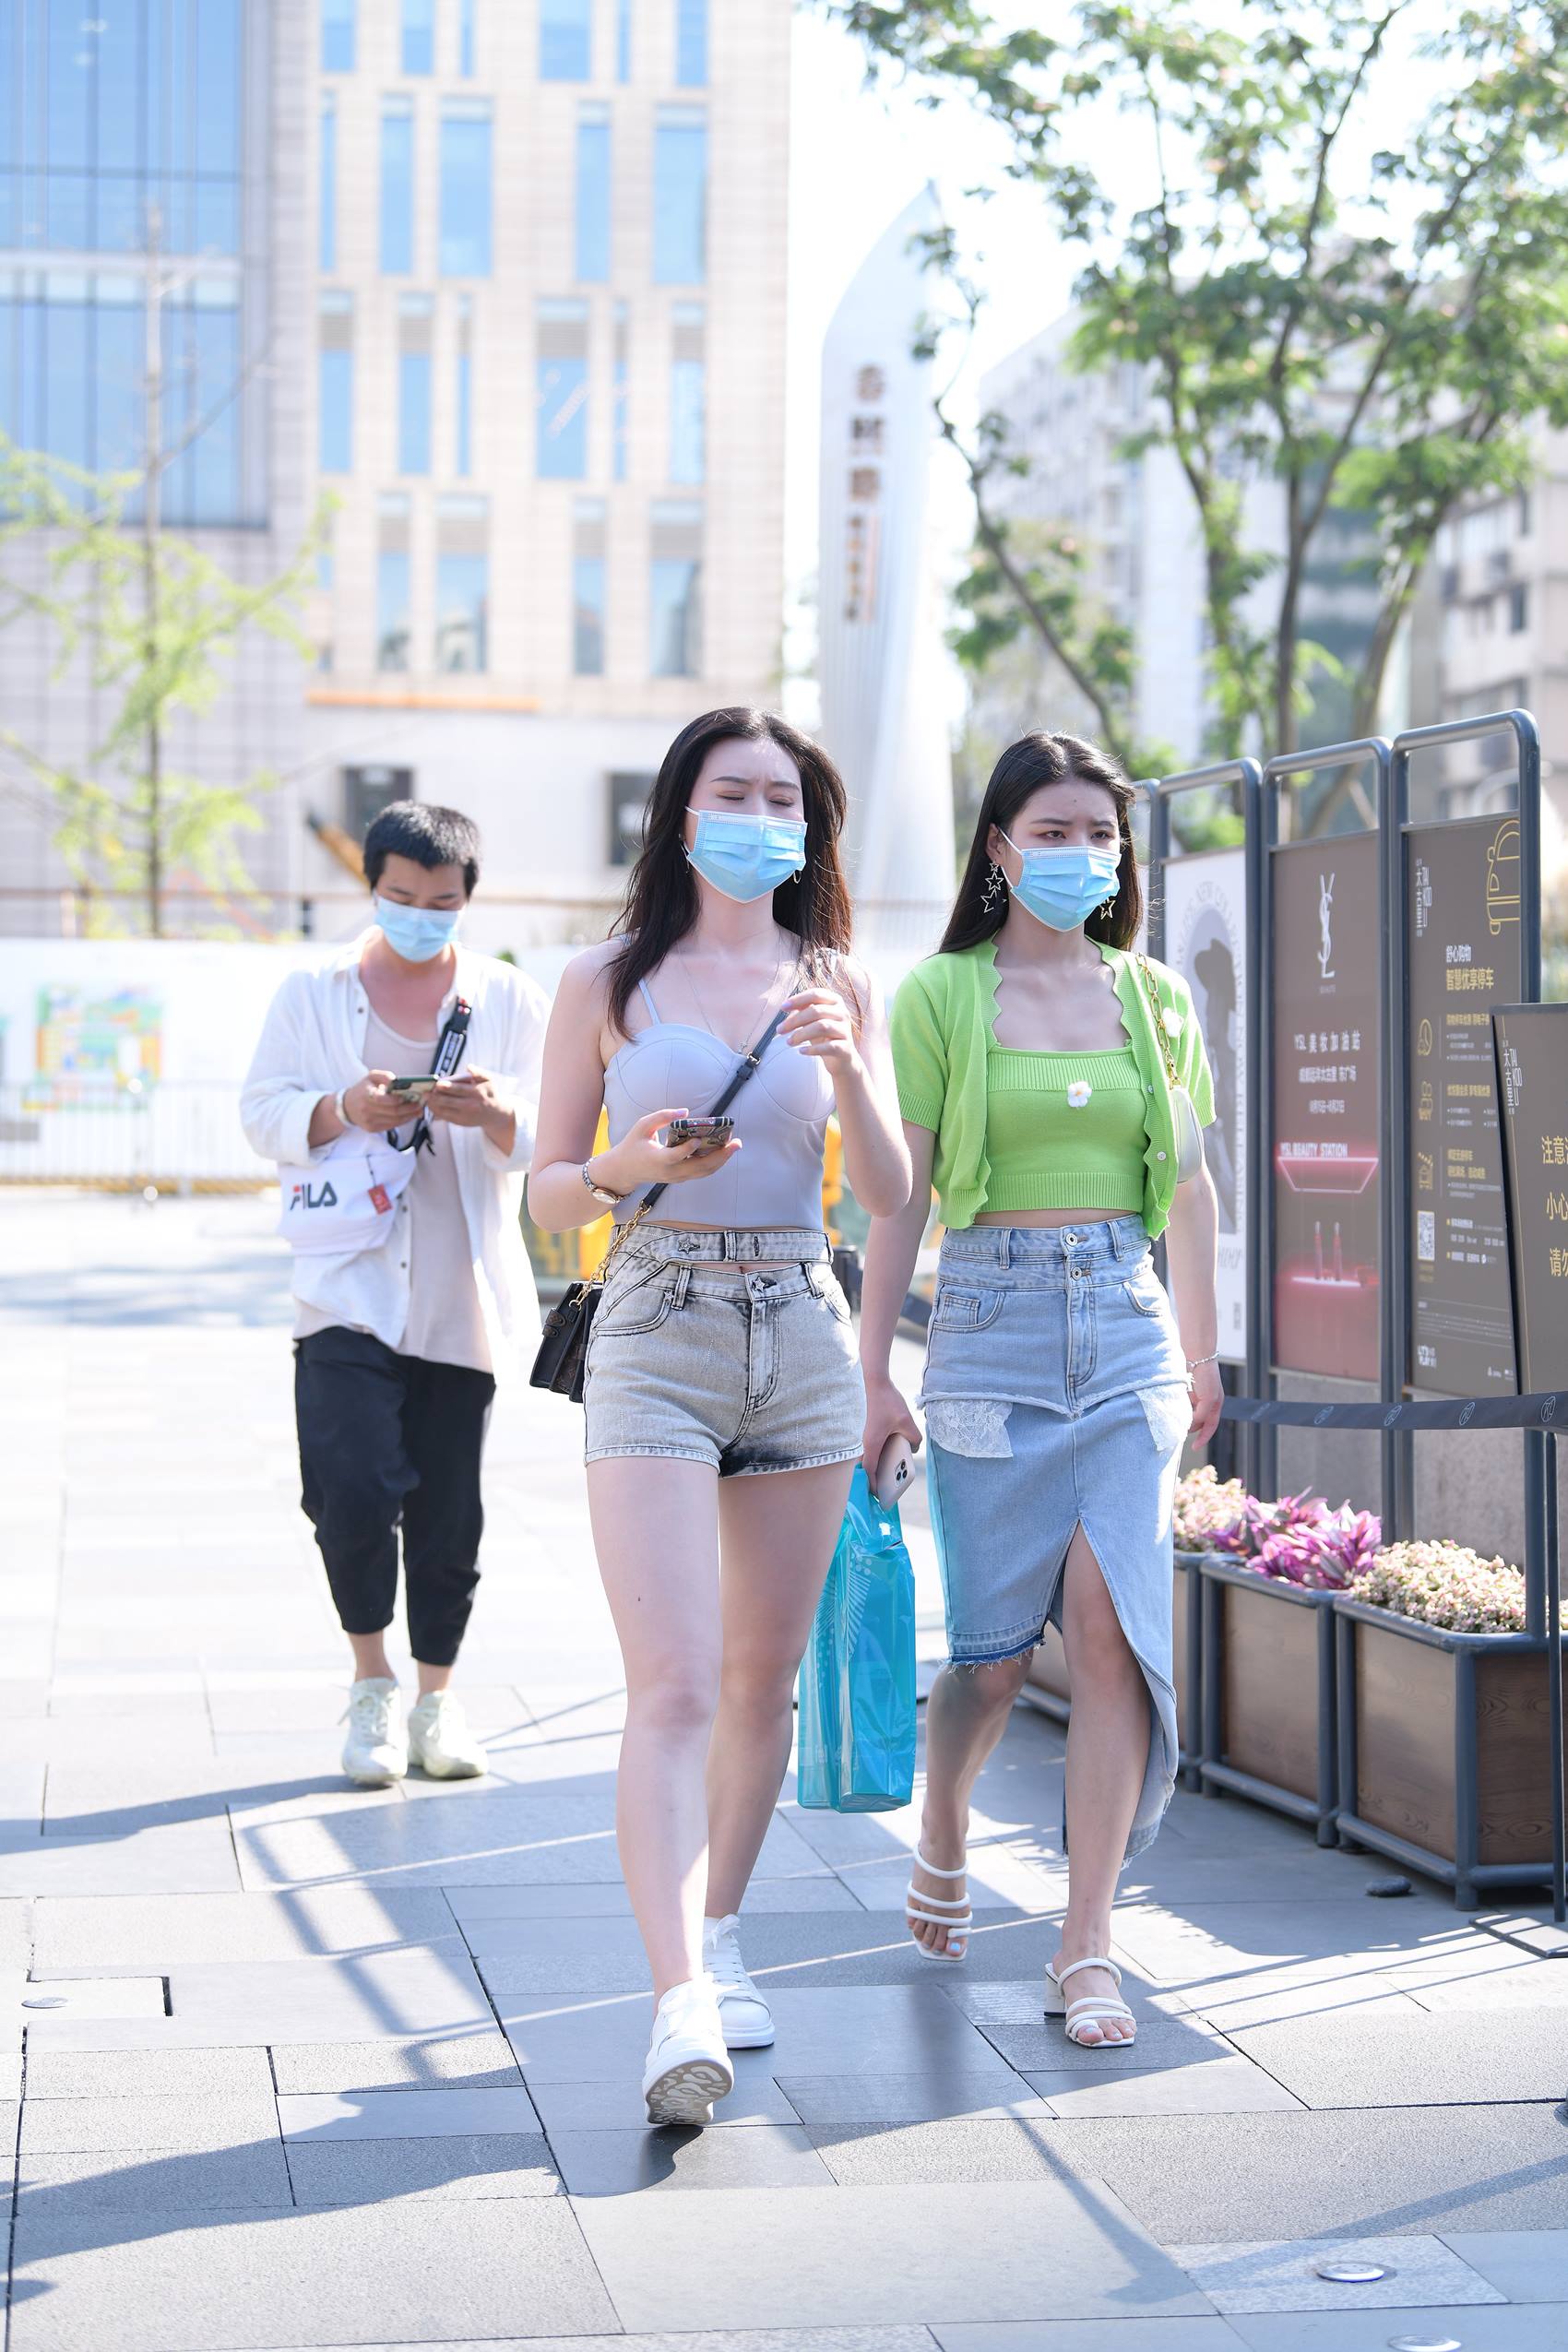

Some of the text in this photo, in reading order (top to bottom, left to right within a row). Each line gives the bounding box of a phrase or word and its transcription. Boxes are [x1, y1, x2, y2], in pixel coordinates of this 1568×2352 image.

[1503, 1048, 1515, 1107] 太古里
[1321, 1143, 1348, 1158] STATION
[1541, 1135, 1568, 1166] 注意
[290, 1181, 338, 1211] FILA
